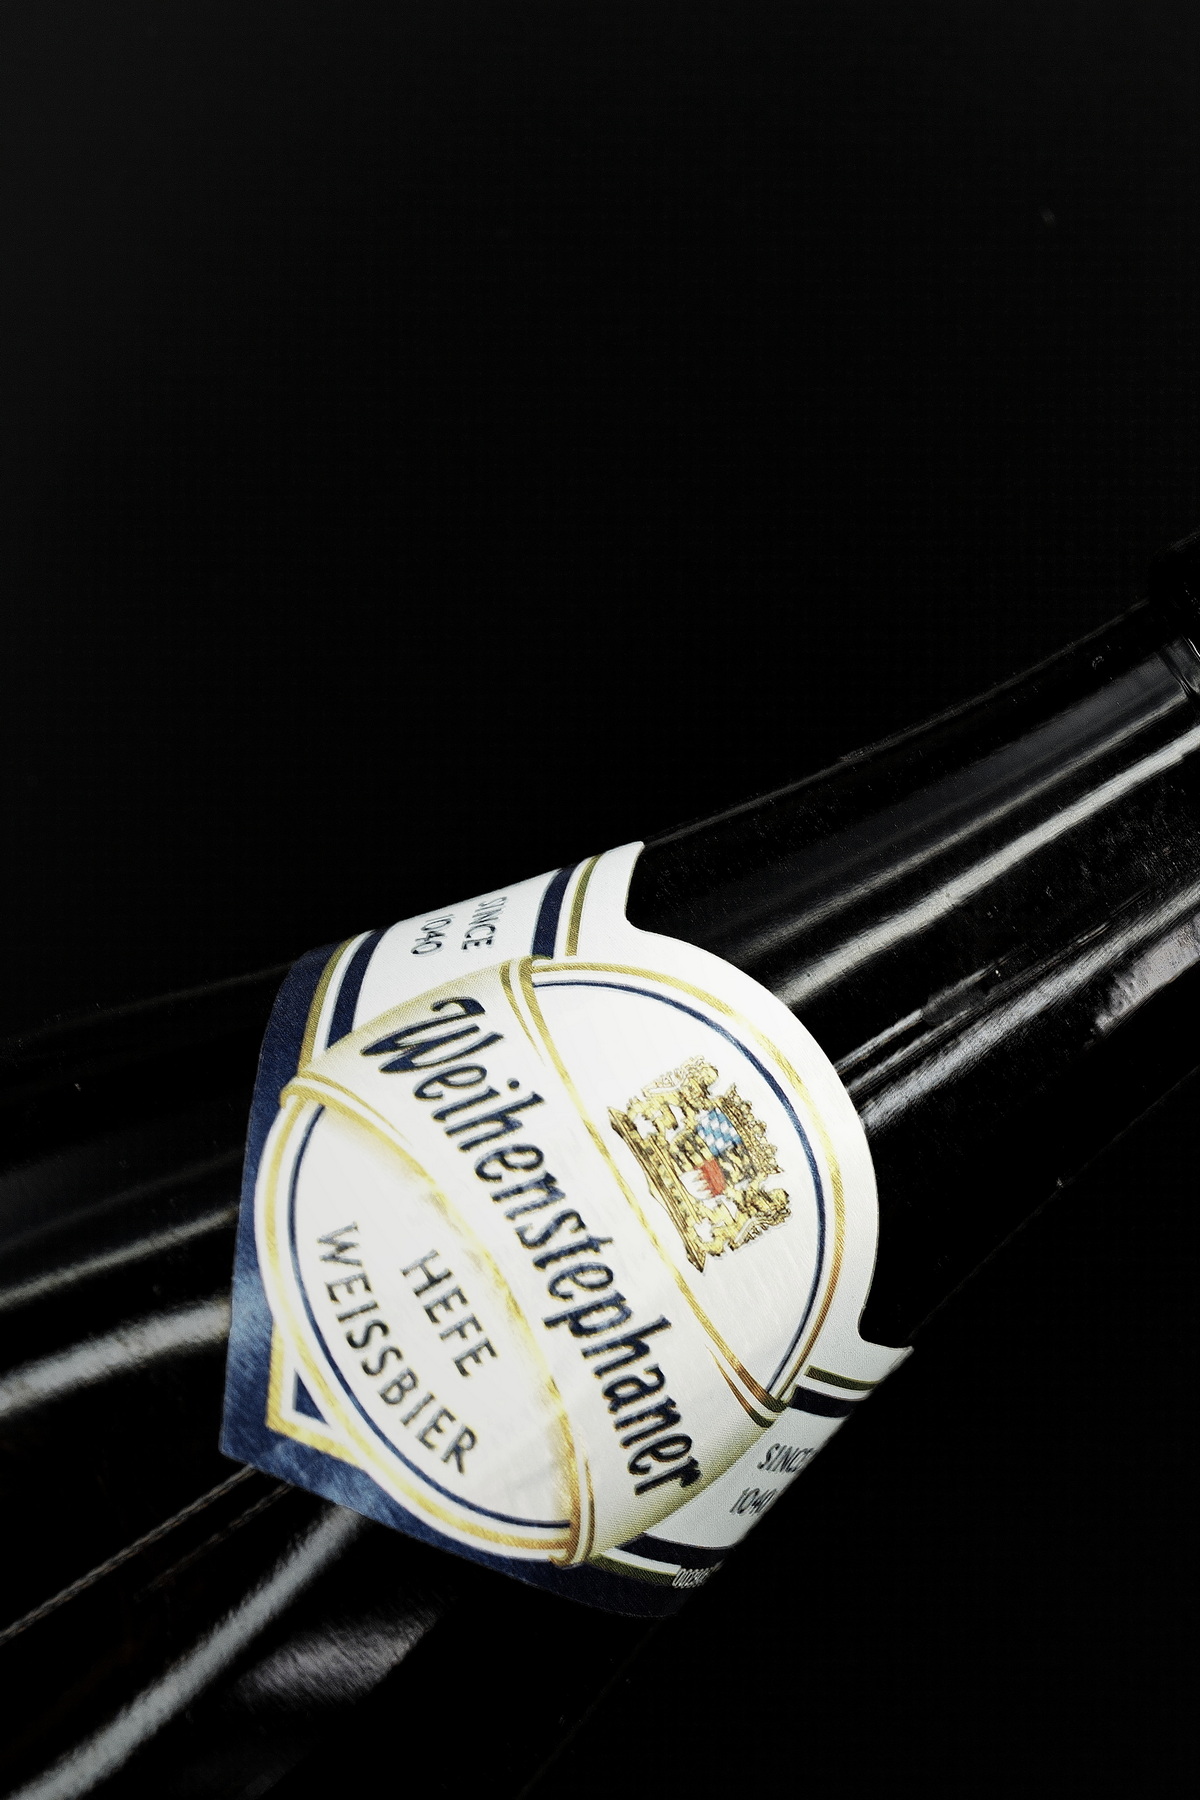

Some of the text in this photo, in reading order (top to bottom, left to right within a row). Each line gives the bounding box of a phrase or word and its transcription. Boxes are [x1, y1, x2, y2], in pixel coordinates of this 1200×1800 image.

[411, 914, 455, 956] 1040
[461, 896, 507, 951] SINCE
[360, 996, 704, 1496] Weihenstephaner
[316, 1221, 479, 1475] WEISSBIER
[401, 1248, 498, 1378] HEFE
